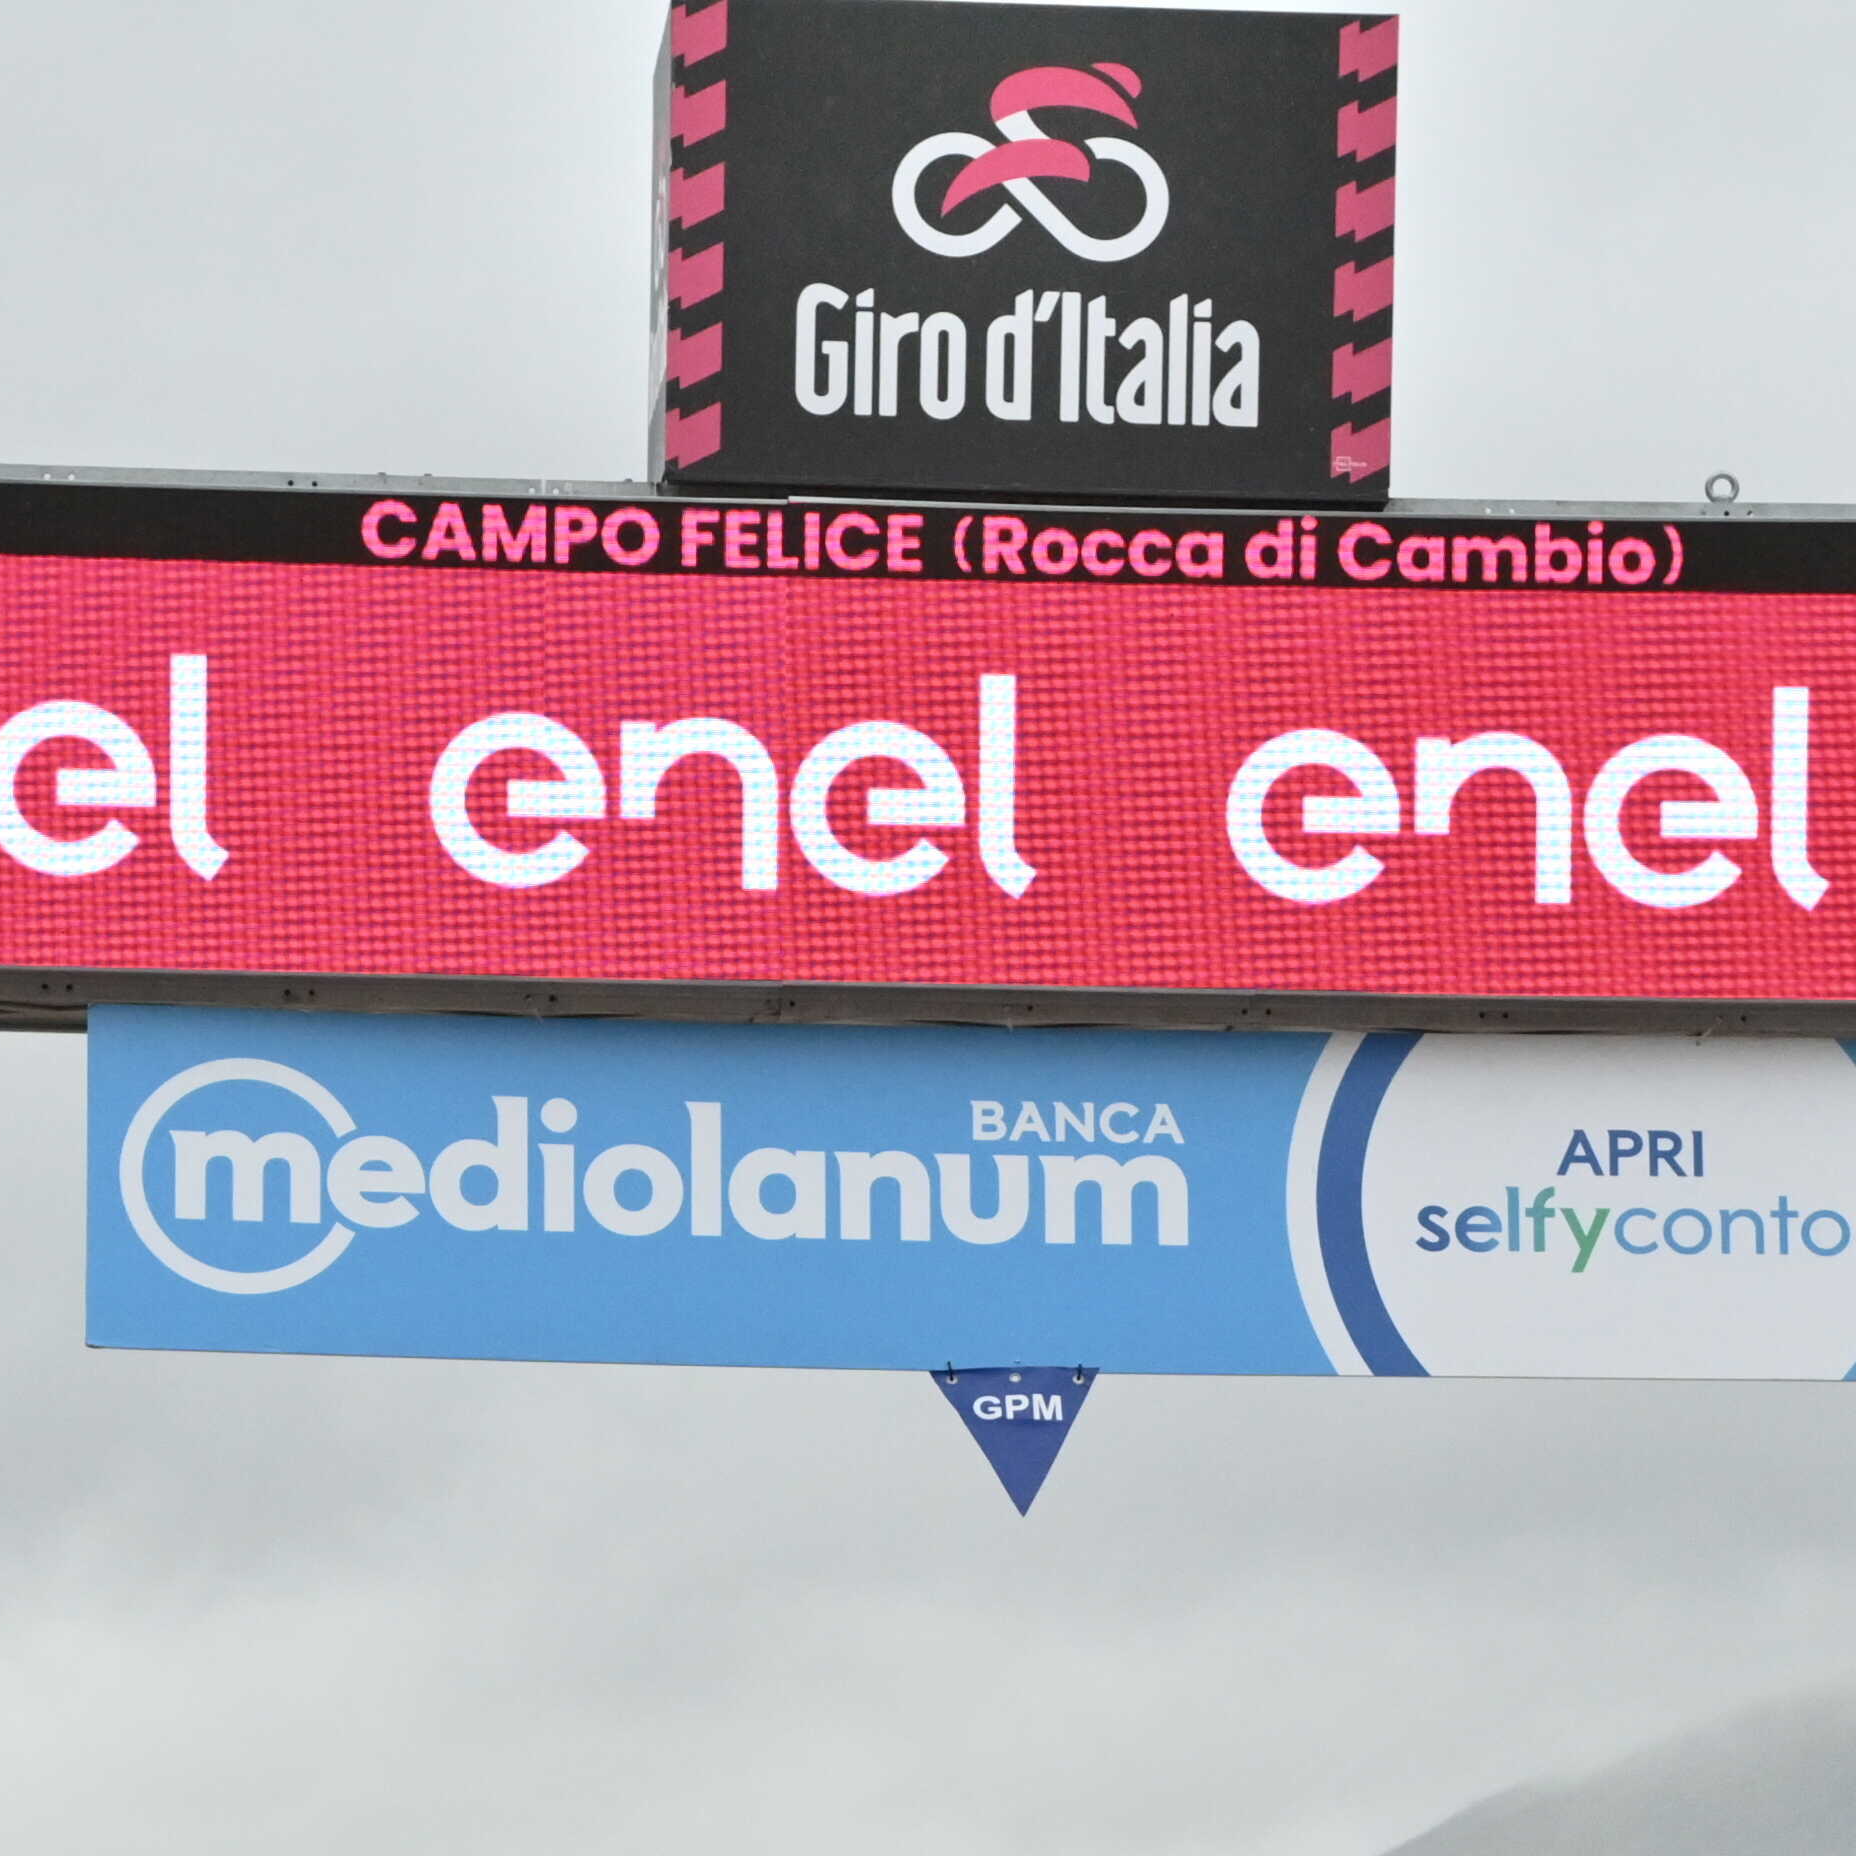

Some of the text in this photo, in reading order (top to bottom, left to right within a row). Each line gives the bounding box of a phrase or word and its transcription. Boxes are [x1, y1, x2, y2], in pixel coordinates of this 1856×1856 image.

[796, 283, 1259, 428] Giro d'Italia
[361, 501, 1684, 588] CAMPO FELICE (Rocca di Cambio)
[429, 673, 1038, 900] enel
[1224, 684, 1830, 913] enel
[970, 1099, 1184, 1144] BANCA
[1558, 1129, 1703, 1177] APRI
[168, 1095, 1190, 1246] mediolanum
[1415, 1186, 1852, 1273] selfyconto
[971, 1393, 1064, 1422] GPM
